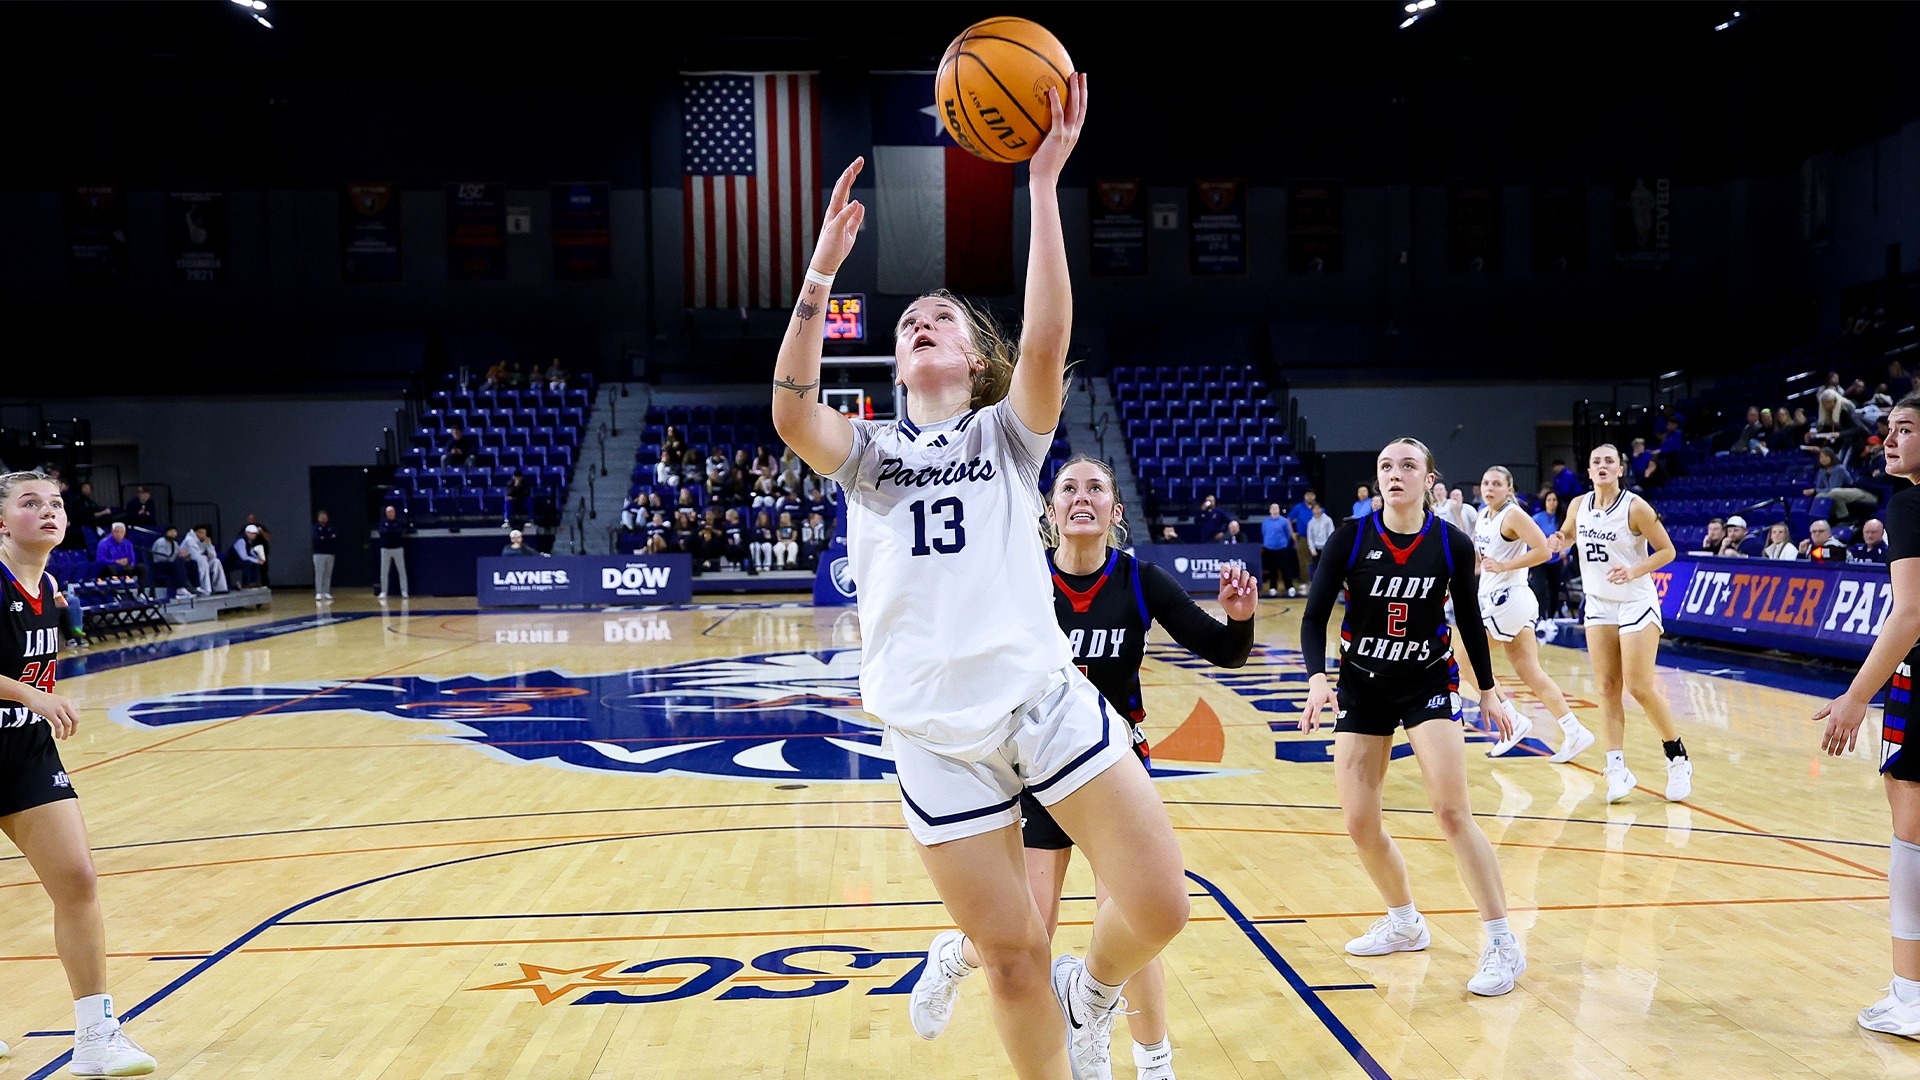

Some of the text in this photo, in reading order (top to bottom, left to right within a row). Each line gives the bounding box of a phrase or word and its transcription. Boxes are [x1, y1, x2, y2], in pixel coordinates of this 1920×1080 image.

[458, 183, 486, 200] LSC
[827, 313, 857, 339] 23
[875, 456, 997, 490] Patriots
[909, 496, 966, 557] 13
[1578, 525, 1617, 542] Patriots
[1191, 558, 1247, 572] UTHelth
[1585, 543, 1609, 563] 25
[492, 569, 569, 585] LAYNE'S
[602, 566, 671, 589] DOW
[1369, 575, 1436, 599] LADY
[1686, 570, 1825, 627] UT TYLER
[1387, 602, 1408, 637] 2
[22, 626, 59, 657] LADY
[1069, 628, 1127, 658] ADY
[1357, 637, 1431, 661] CHAPS
[19, 659, 57, 694] 24
[569, 944, 929, 1006] LSC
